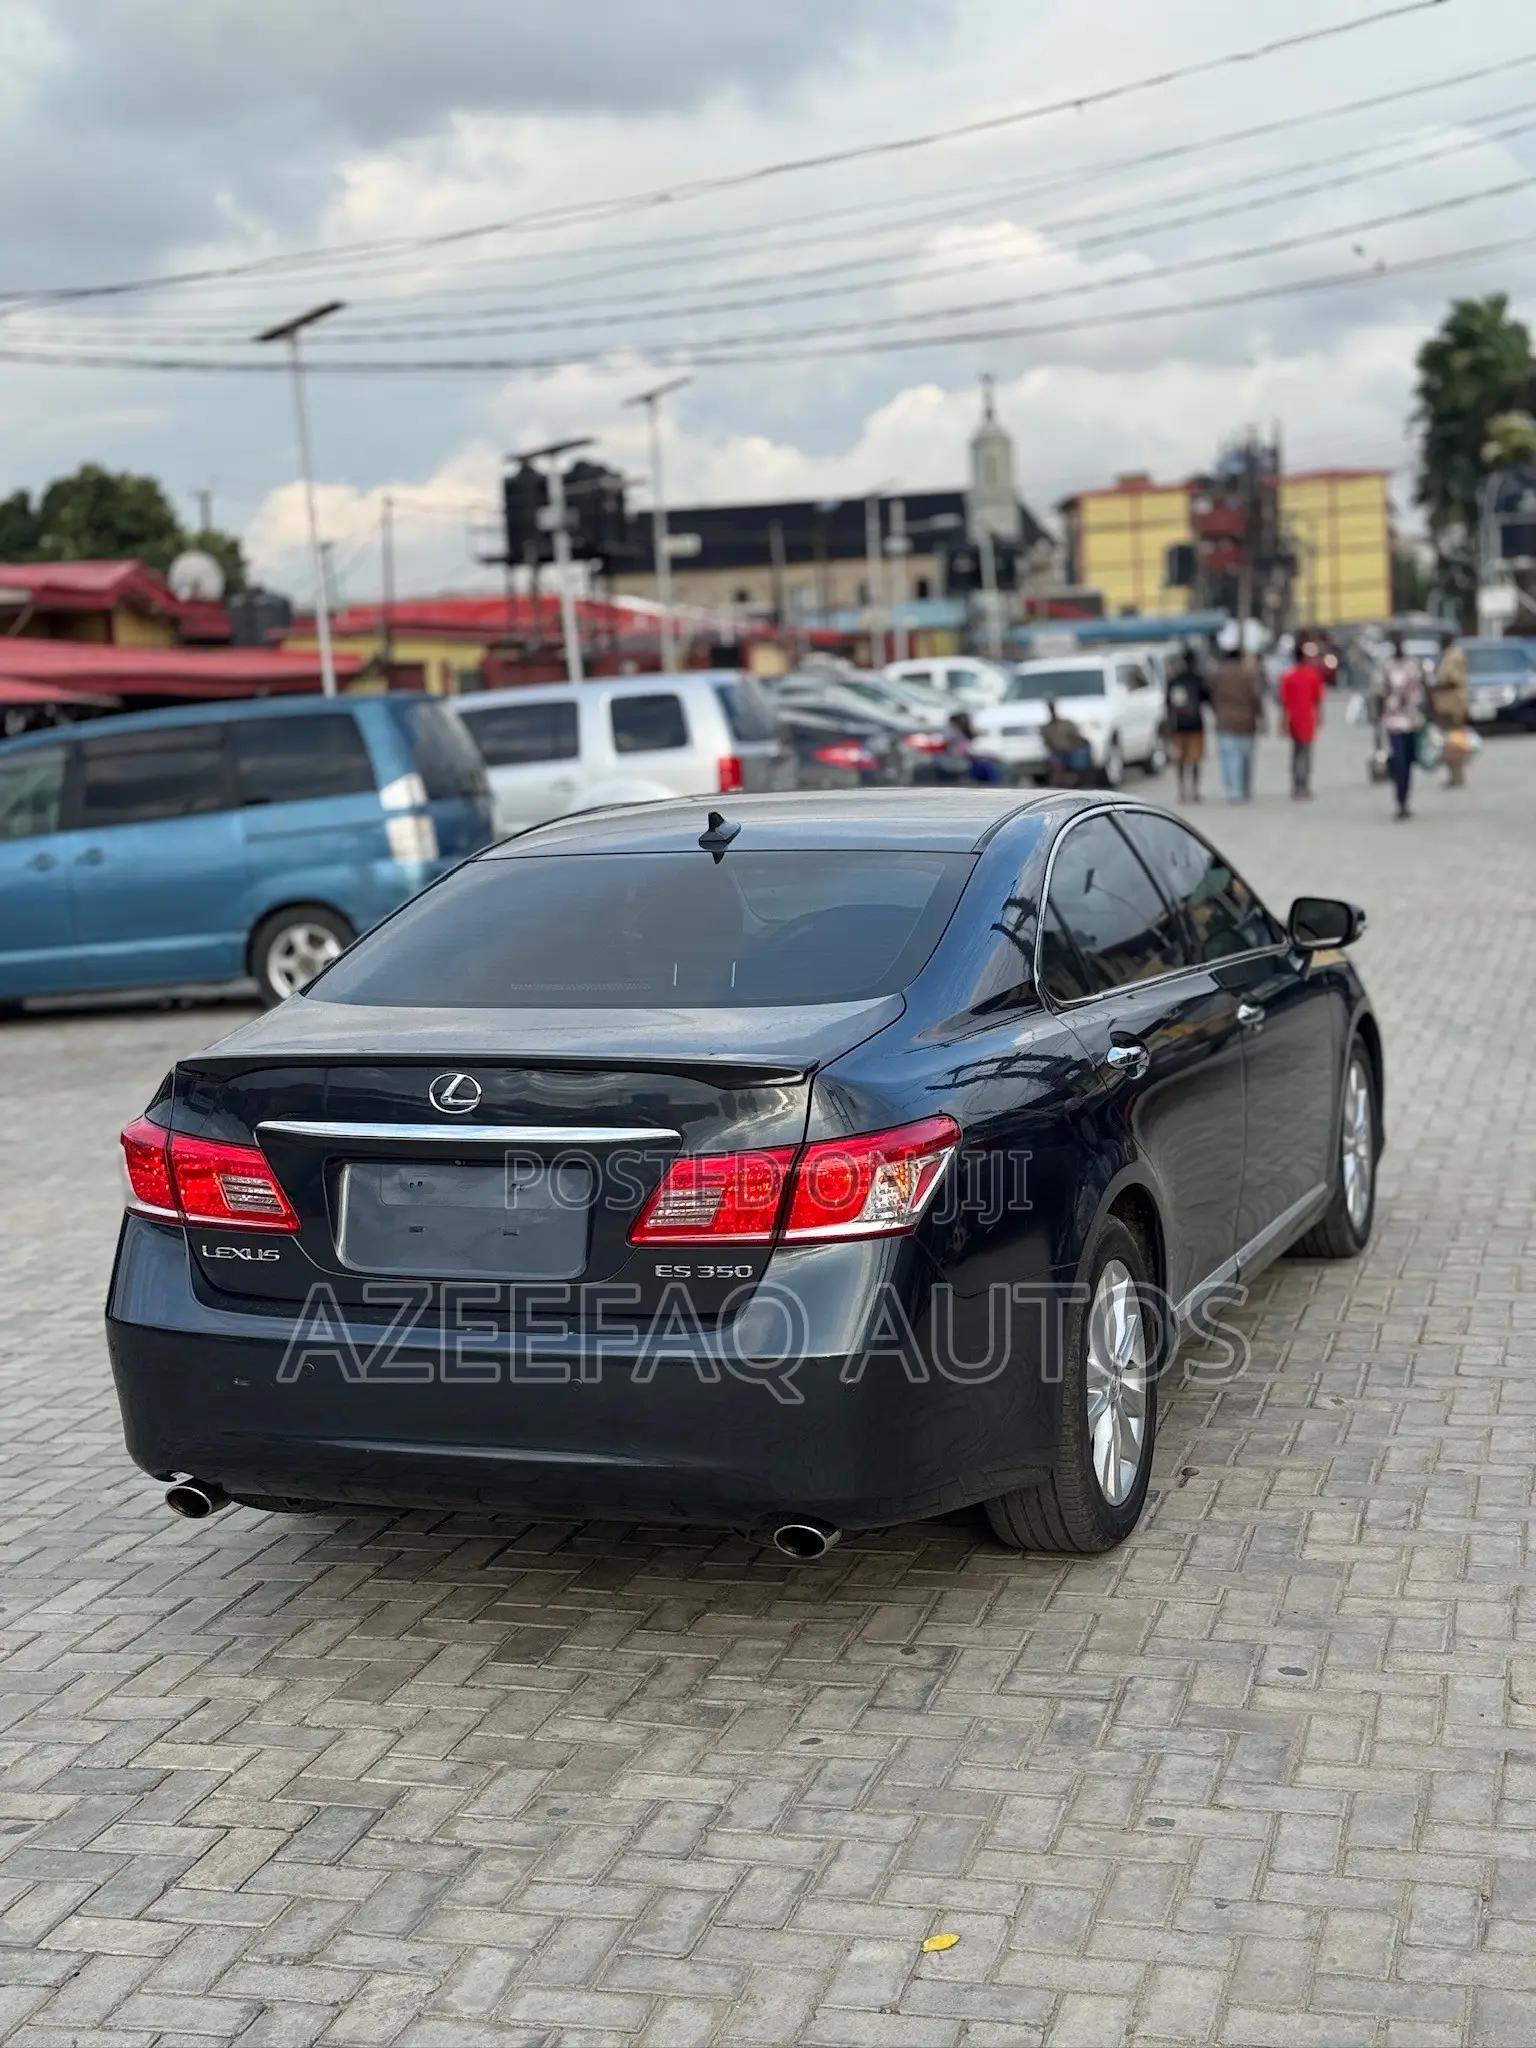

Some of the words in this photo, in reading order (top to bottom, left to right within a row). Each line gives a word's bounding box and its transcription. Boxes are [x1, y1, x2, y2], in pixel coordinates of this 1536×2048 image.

[202, 1244, 280, 1261] LEXUS
[655, 1264, 691, 1278] ES
[697, 1264, 753, 1278] 350
